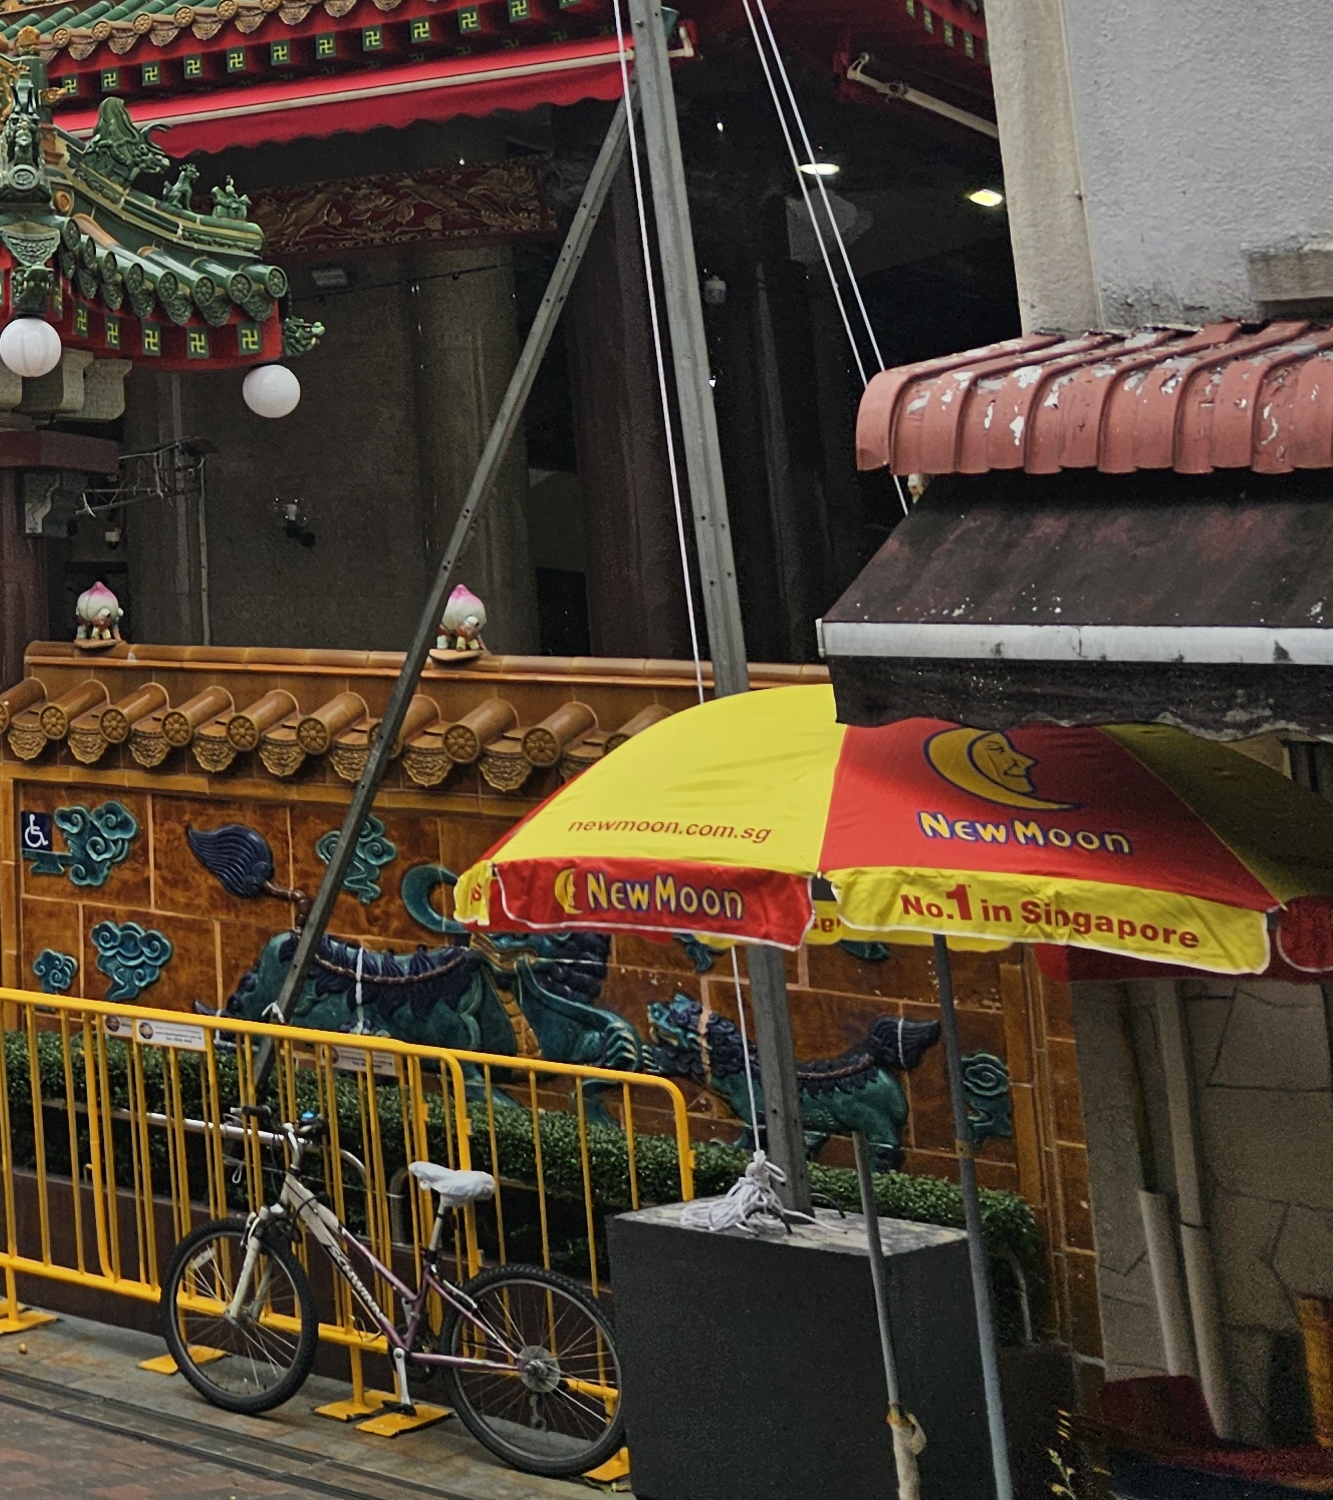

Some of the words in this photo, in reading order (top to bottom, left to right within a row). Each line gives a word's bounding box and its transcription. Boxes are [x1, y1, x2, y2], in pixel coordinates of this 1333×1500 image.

[568, 818, 773, 844] newmoon.com.sg
[981, 899, 1013, 922] in
[1020, 900, 1200, 949] Singapore
[327, 1243, 385, 1321] SCHWINN
